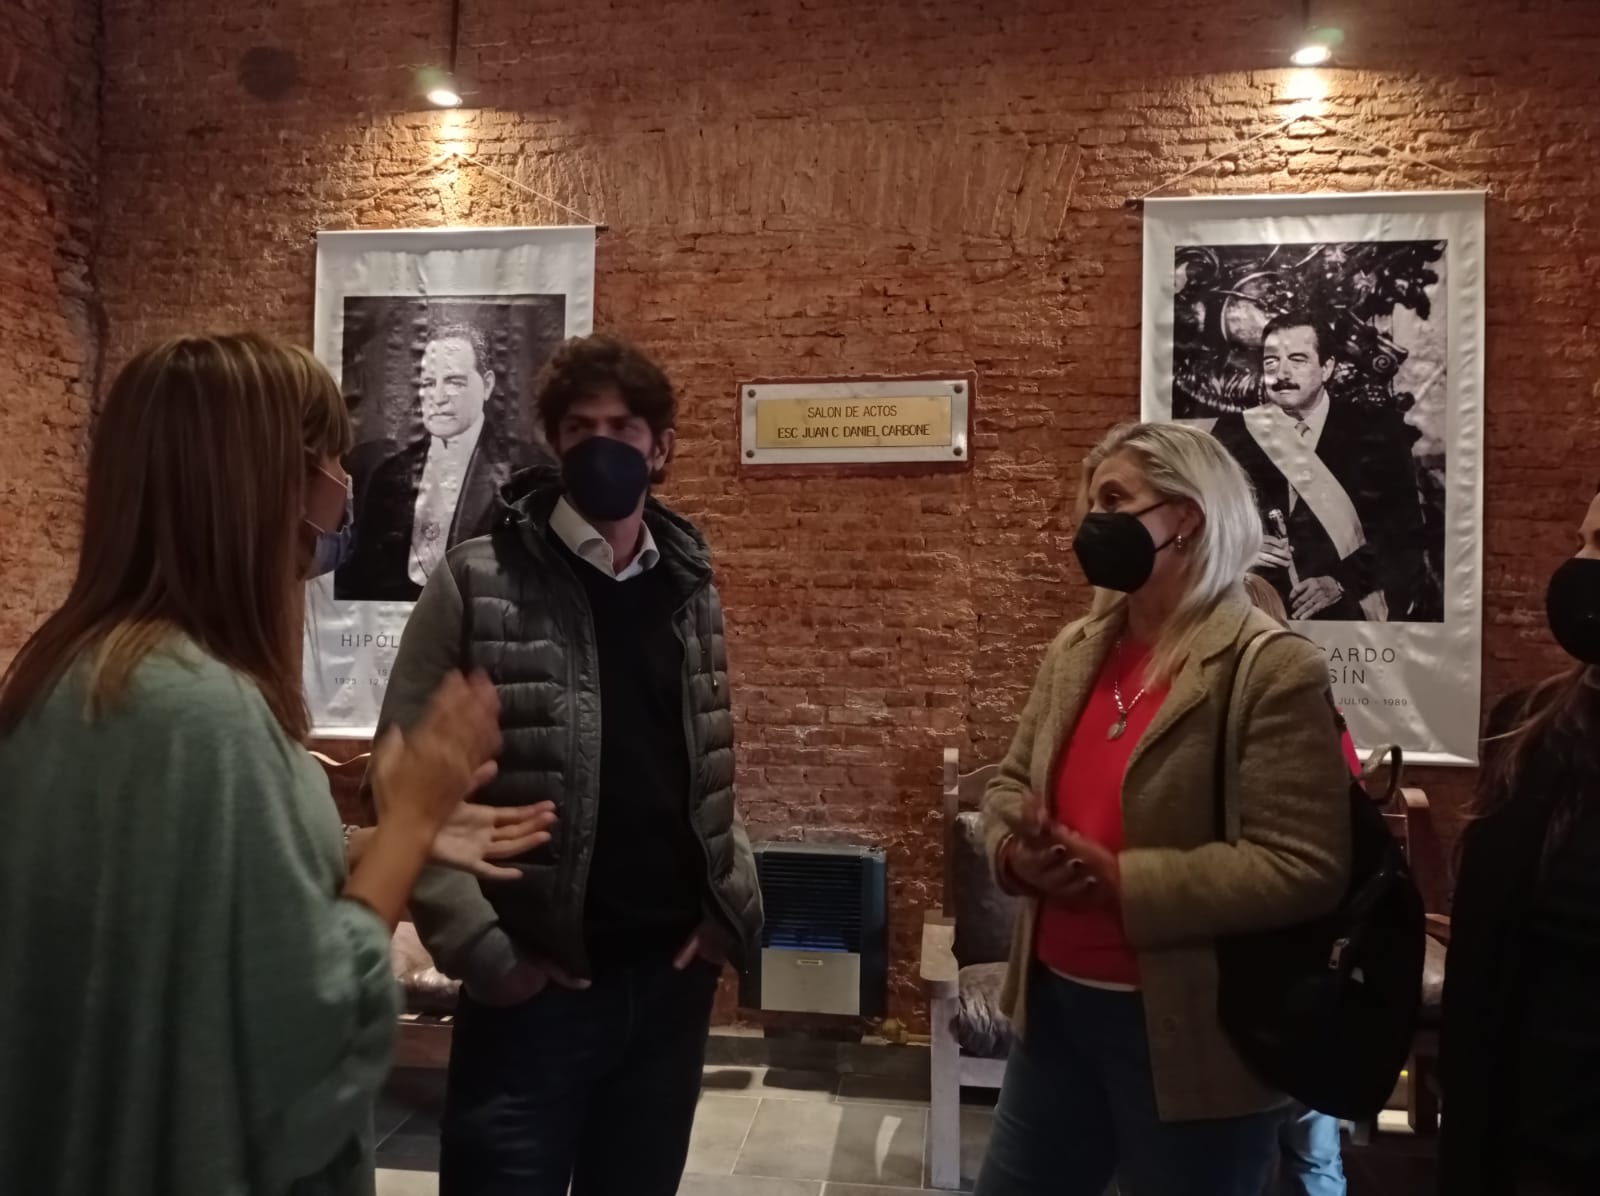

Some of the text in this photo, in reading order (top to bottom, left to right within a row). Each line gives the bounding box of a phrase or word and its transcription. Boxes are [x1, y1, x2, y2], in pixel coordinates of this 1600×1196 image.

[807, 405, 898, 418] SALON DE ACTOS
[777, 427, 799, 439] ESC
[801, 426, 829, 438] JUAN
[843, 425, 880, 437] DANIEL
[881, 424, 931, 437] CARBONE
[1318, 647, 1396, 663] ARDO
[1338, 698, 1369, 706] JULIO
